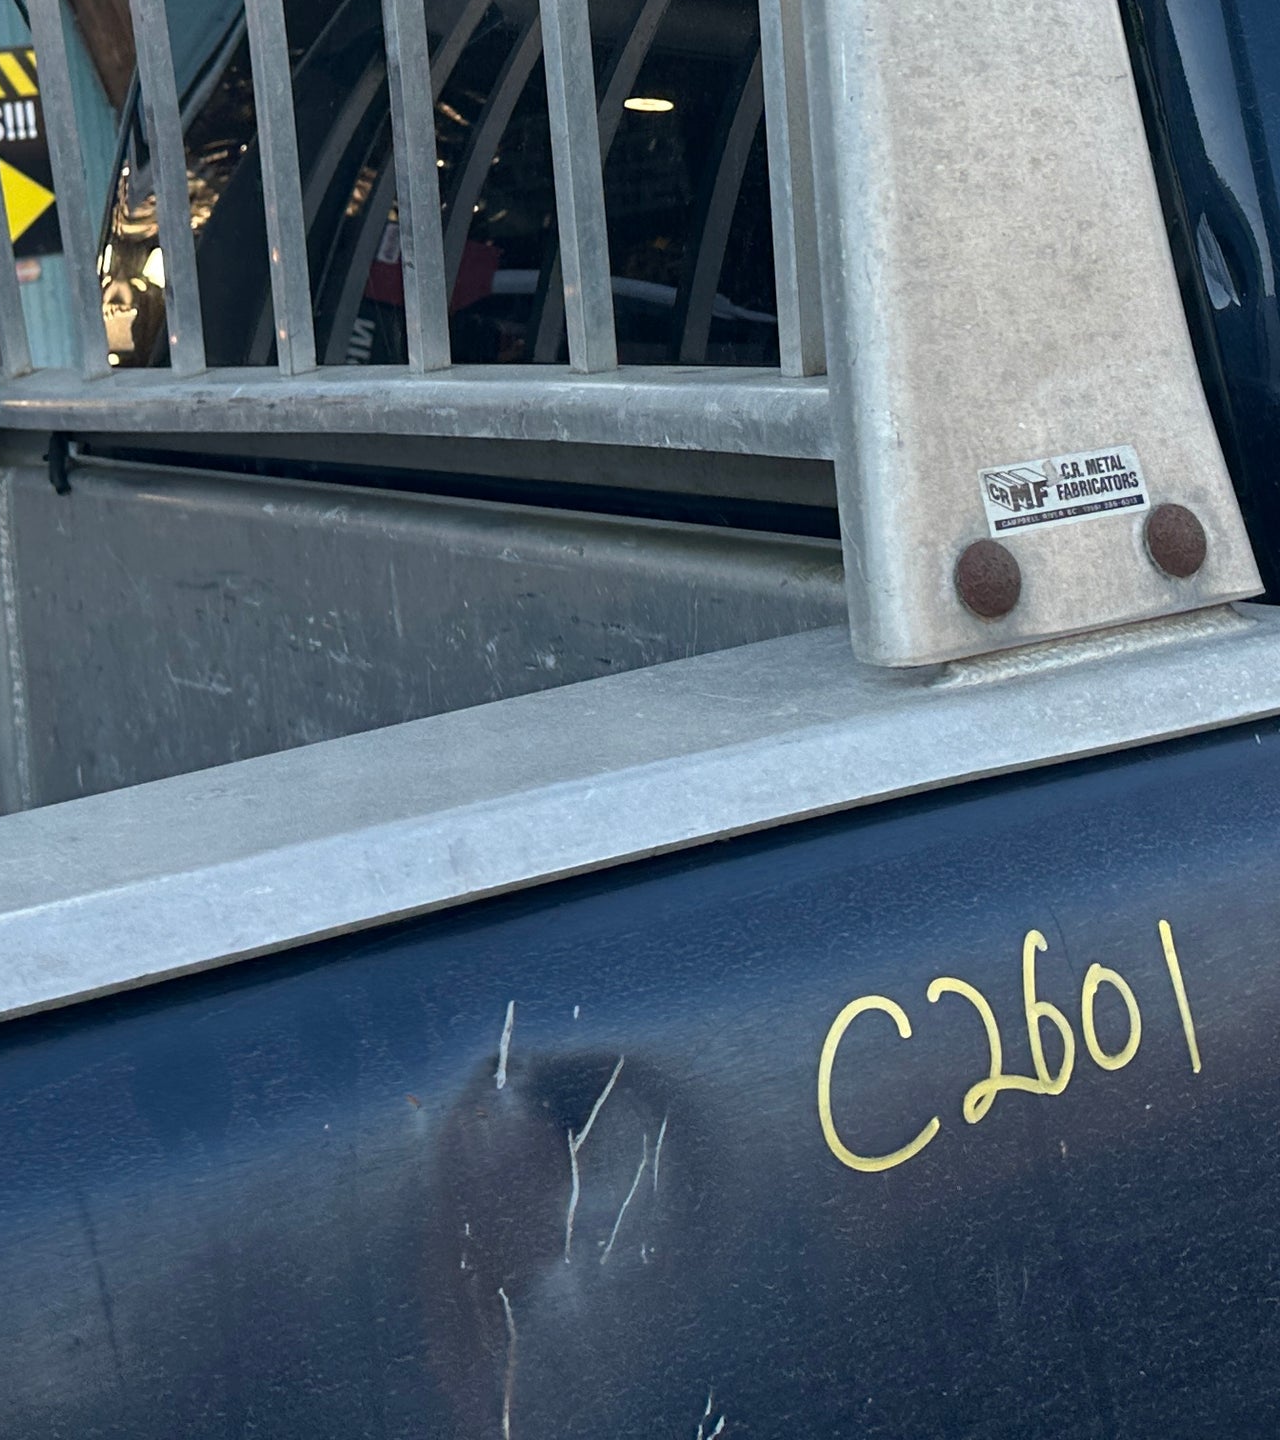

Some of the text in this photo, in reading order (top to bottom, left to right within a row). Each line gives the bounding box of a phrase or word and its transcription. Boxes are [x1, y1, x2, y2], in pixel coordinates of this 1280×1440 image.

[1060, 454, 1126, 479] C.R. METAL
[1056, 471, 1139, 501] FABRICATORS
[817, 919, 1202, 1173] C2601
